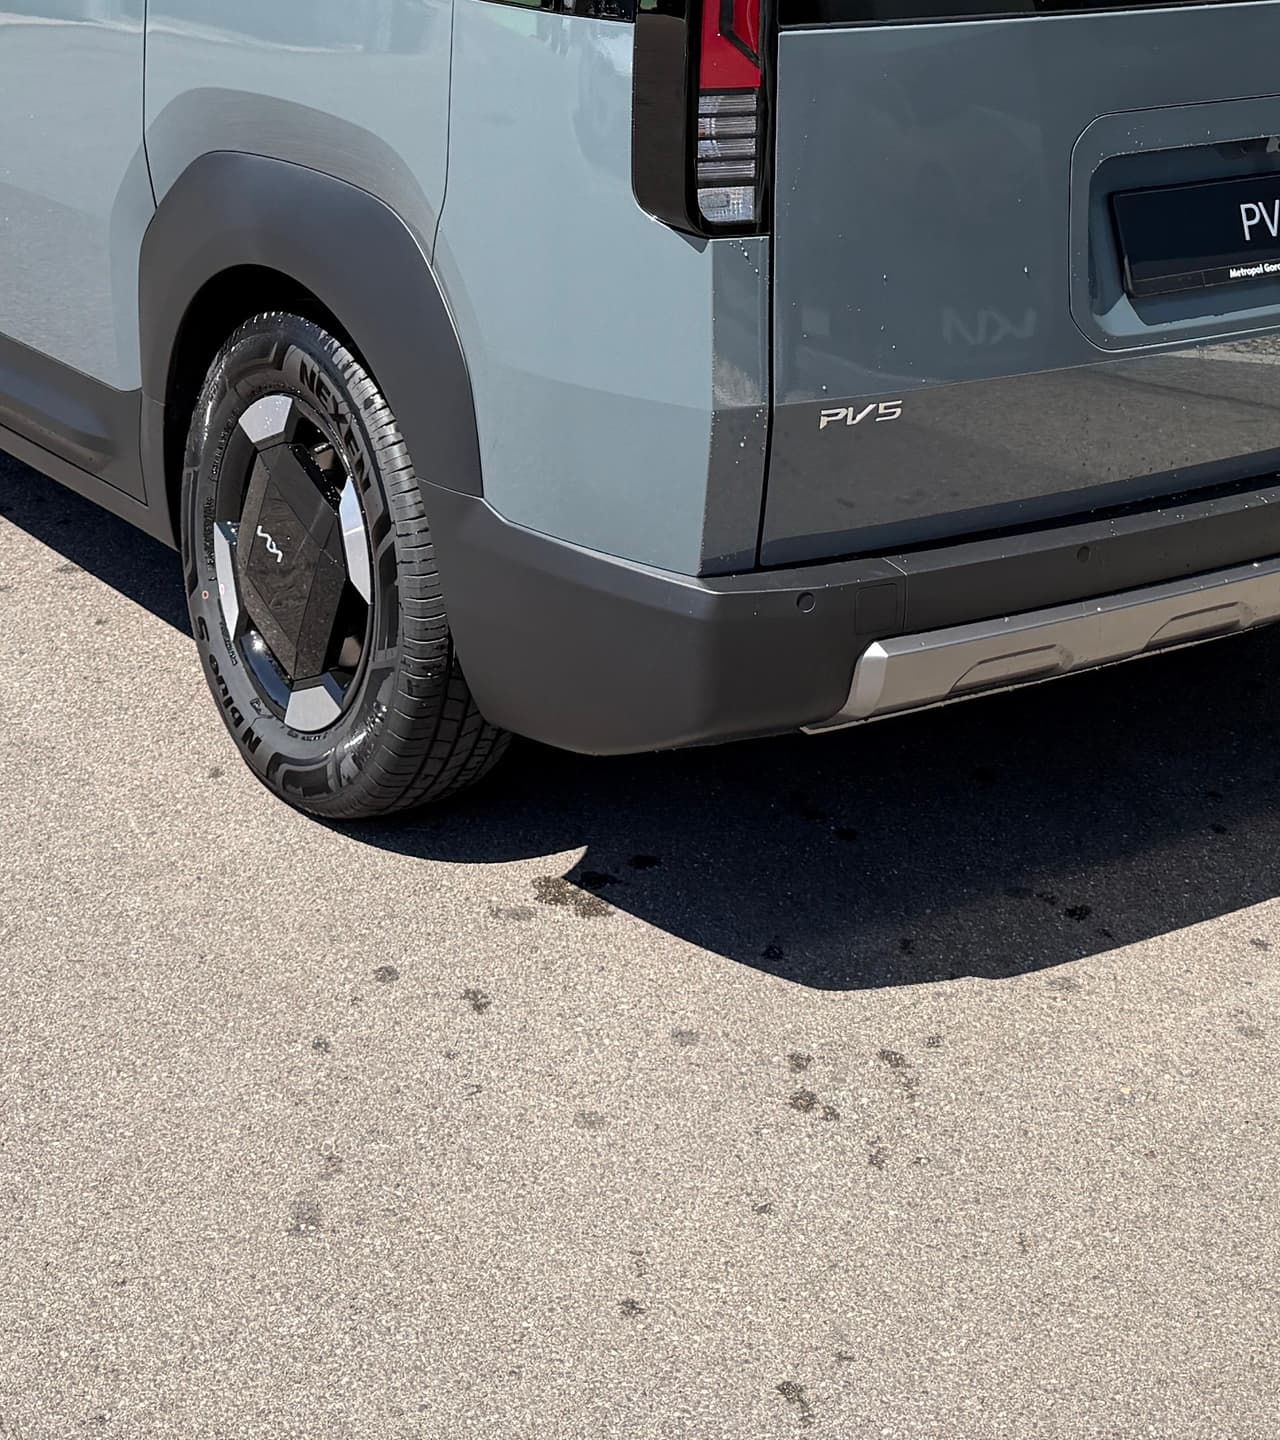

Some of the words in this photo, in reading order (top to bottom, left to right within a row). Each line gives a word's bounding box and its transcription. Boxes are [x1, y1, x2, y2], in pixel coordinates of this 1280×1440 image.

[1229, 264, 1264, 278] Metropol
[299, 360, 372, 494] NEXEN
[819, 400, 903, 430] PV5
